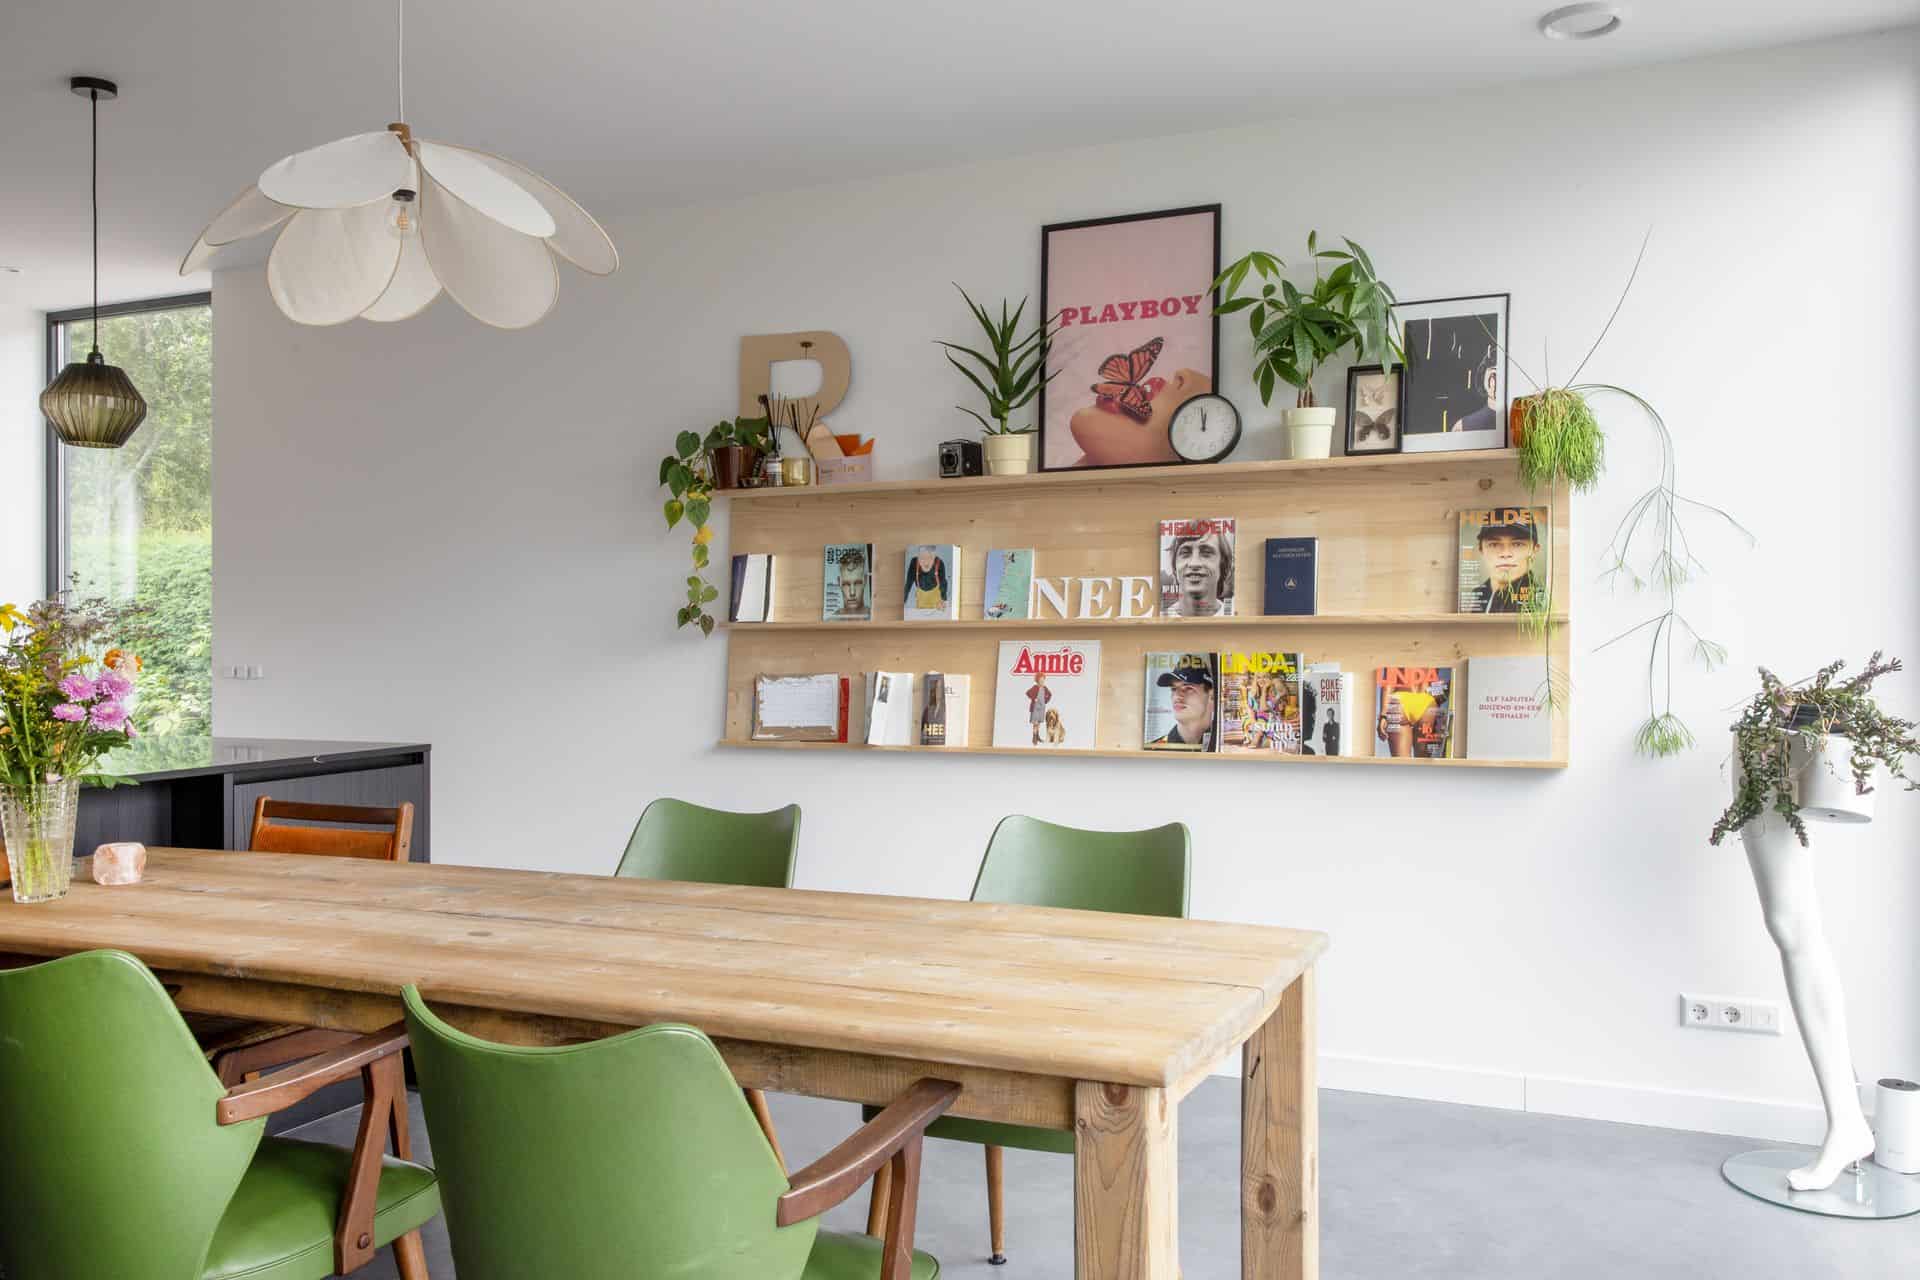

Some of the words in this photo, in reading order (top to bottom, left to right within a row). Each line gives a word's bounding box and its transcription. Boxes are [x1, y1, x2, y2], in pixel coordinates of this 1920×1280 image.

[1059, 295, 1202, 328] PLAYBOY
[1159, 520, 1235, 537] HELDEN
[1031, 576, 1154, 620] NEE
[1011, 647, 1085, 675] Annie
